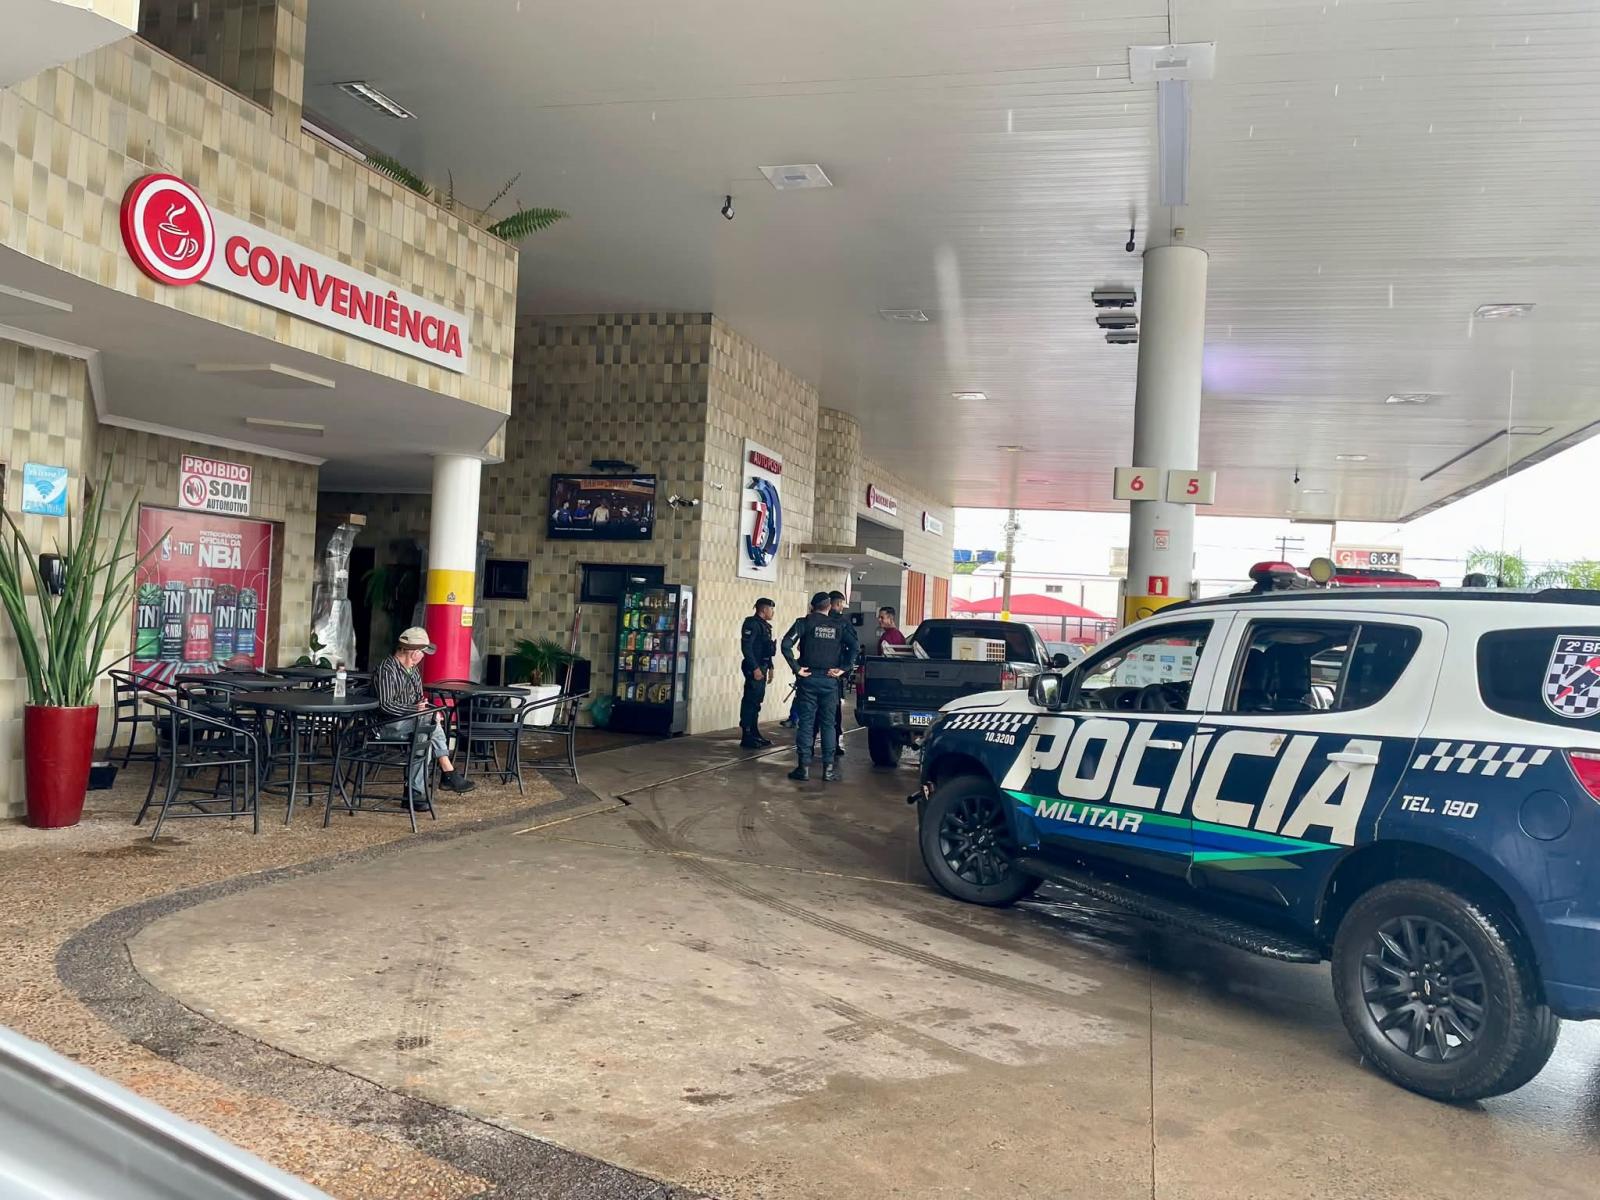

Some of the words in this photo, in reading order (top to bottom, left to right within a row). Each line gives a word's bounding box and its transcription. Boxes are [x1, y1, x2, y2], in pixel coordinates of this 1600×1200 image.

[225, 235, 463, 358] CONVENIÊNCIA
[184, 457, 249, 480] PROIBIDO
[209, 480, 247, 500] SOM
[1130, 475, 1144, 491] 6
[1186, 478, 1200, 495] 5
[206, 498, 248, 513] AUTOMOTIVO
[178, 542, 194, 555] TNT
[199, 536, 230, 546] OFICIAL
[198, 544, 242, 569] NBA
[163, 591, 186, 613] TNT
[189, 588, 215, 613] TNT
[139, 605, 160, 628] TNT
[215, 606, 236, 628] TNT
[984, 731, 1016, 747] 10.3200
[1000, 716, 1383, 847] POLÍCIA
[1034, 799, 1144, 833] MILITAR
[1400, 795, 1436, 814] TEL.
[1441, 799, 1480, 819] 190
